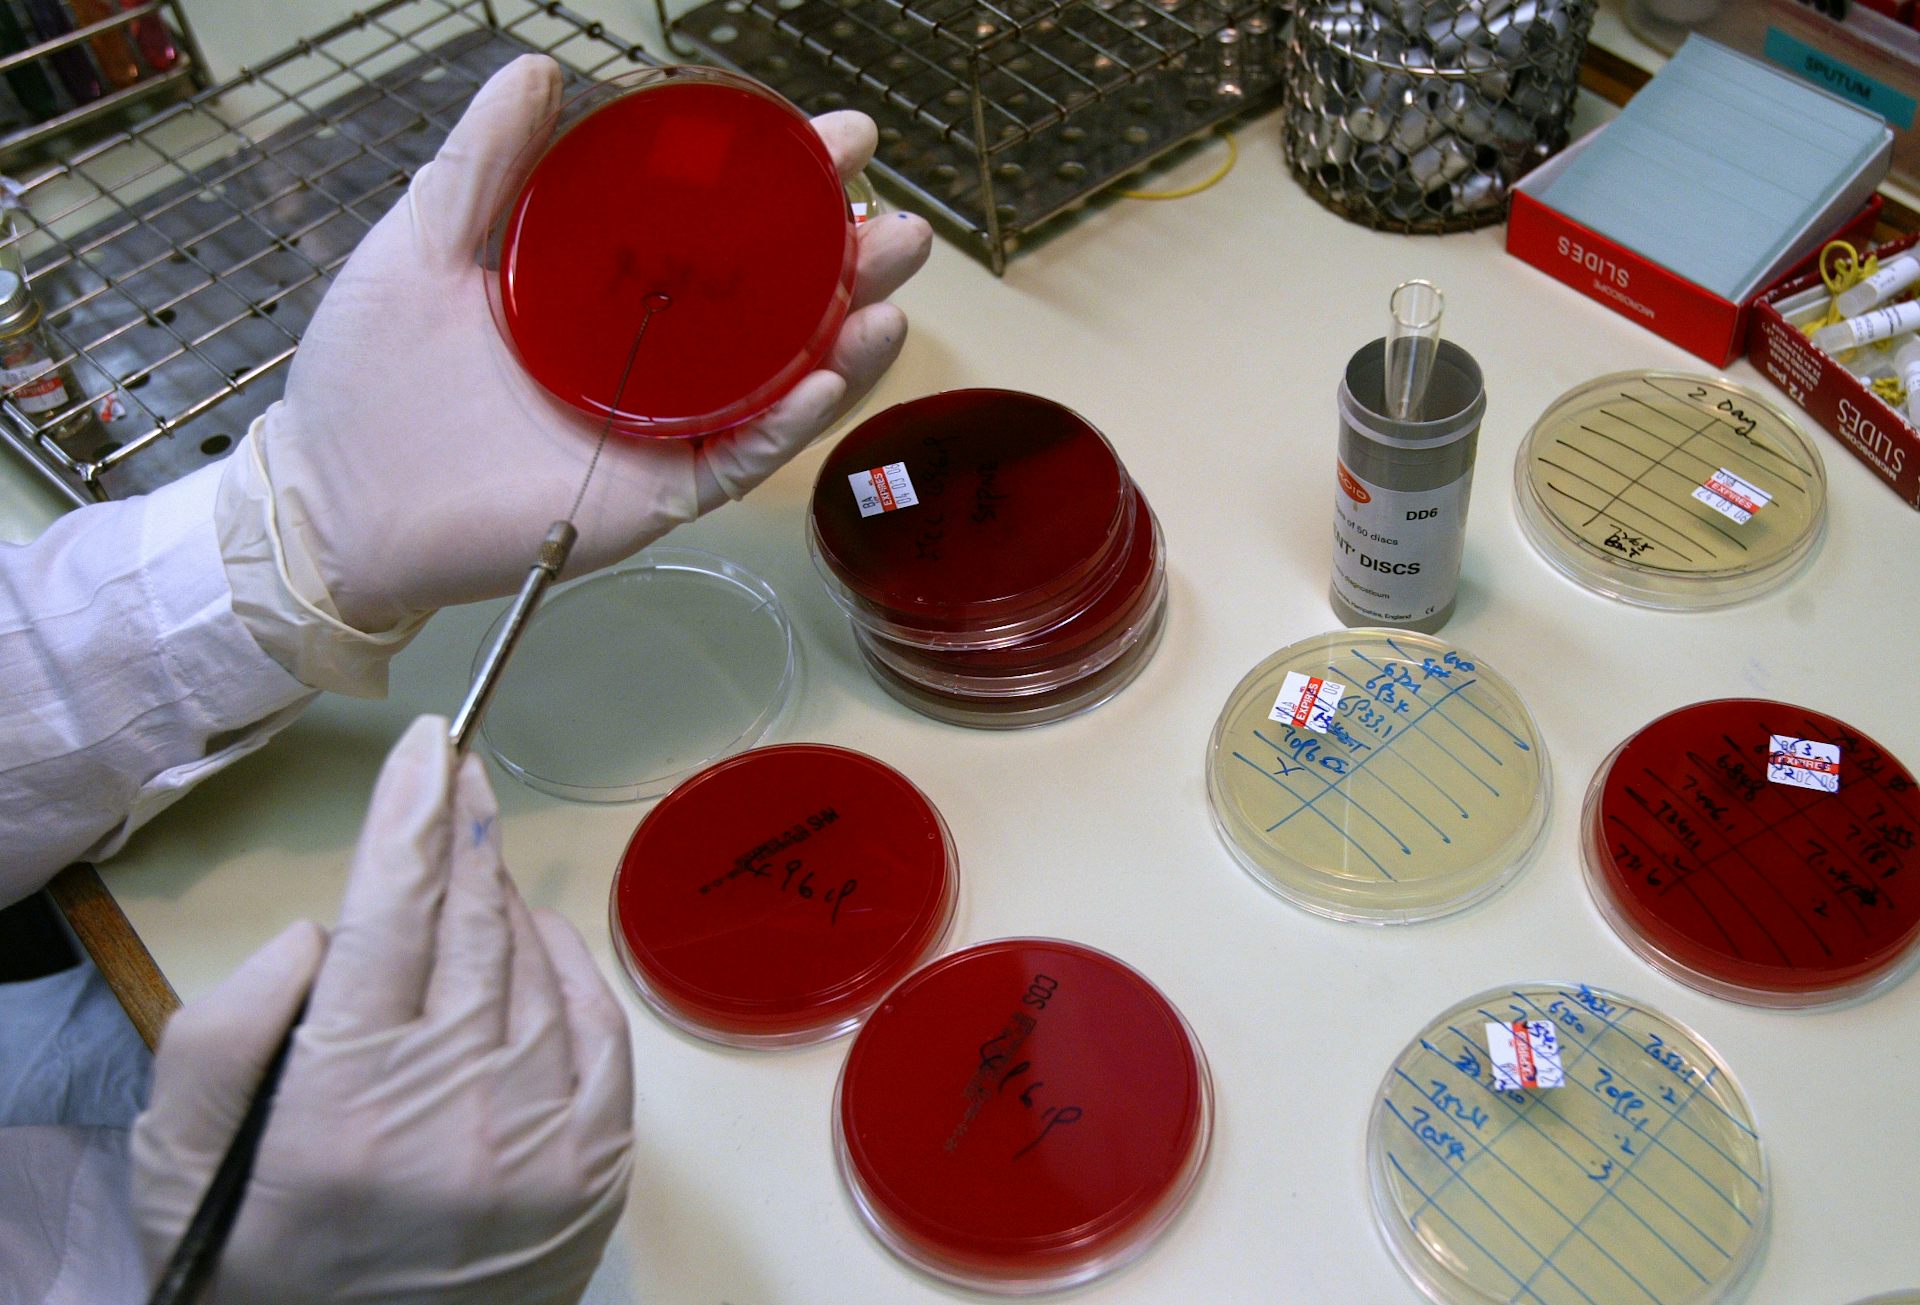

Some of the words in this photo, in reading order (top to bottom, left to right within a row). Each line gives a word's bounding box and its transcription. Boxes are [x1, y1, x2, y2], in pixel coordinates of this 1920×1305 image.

[1805, 55, 1873, 100] SPUTUM
[1558, 236, 1630, 288] SLIDES
[1836, 398, 1906, 473] SLIDES
[1839, 424, 1898, 481] MICROSCOPE
[873, 472, 893, 507] EXPIRES
[889, 477, 906, 491] 03
[895, 491, 912, 506] 04
[1711, 481, 1754, 510] EXPIRES
[862, 495, 877, 511] BA
[1406, 507, 1439, 521] DD6
[1356, 526, 1368, 537] 50
[1370, 533, 1400, 546] discs
[1360, 553, 1421, 575] DISCS
[1296, 683, 1319, 722] EXPIRES
[1022, 974, 1058, 1010] COS
